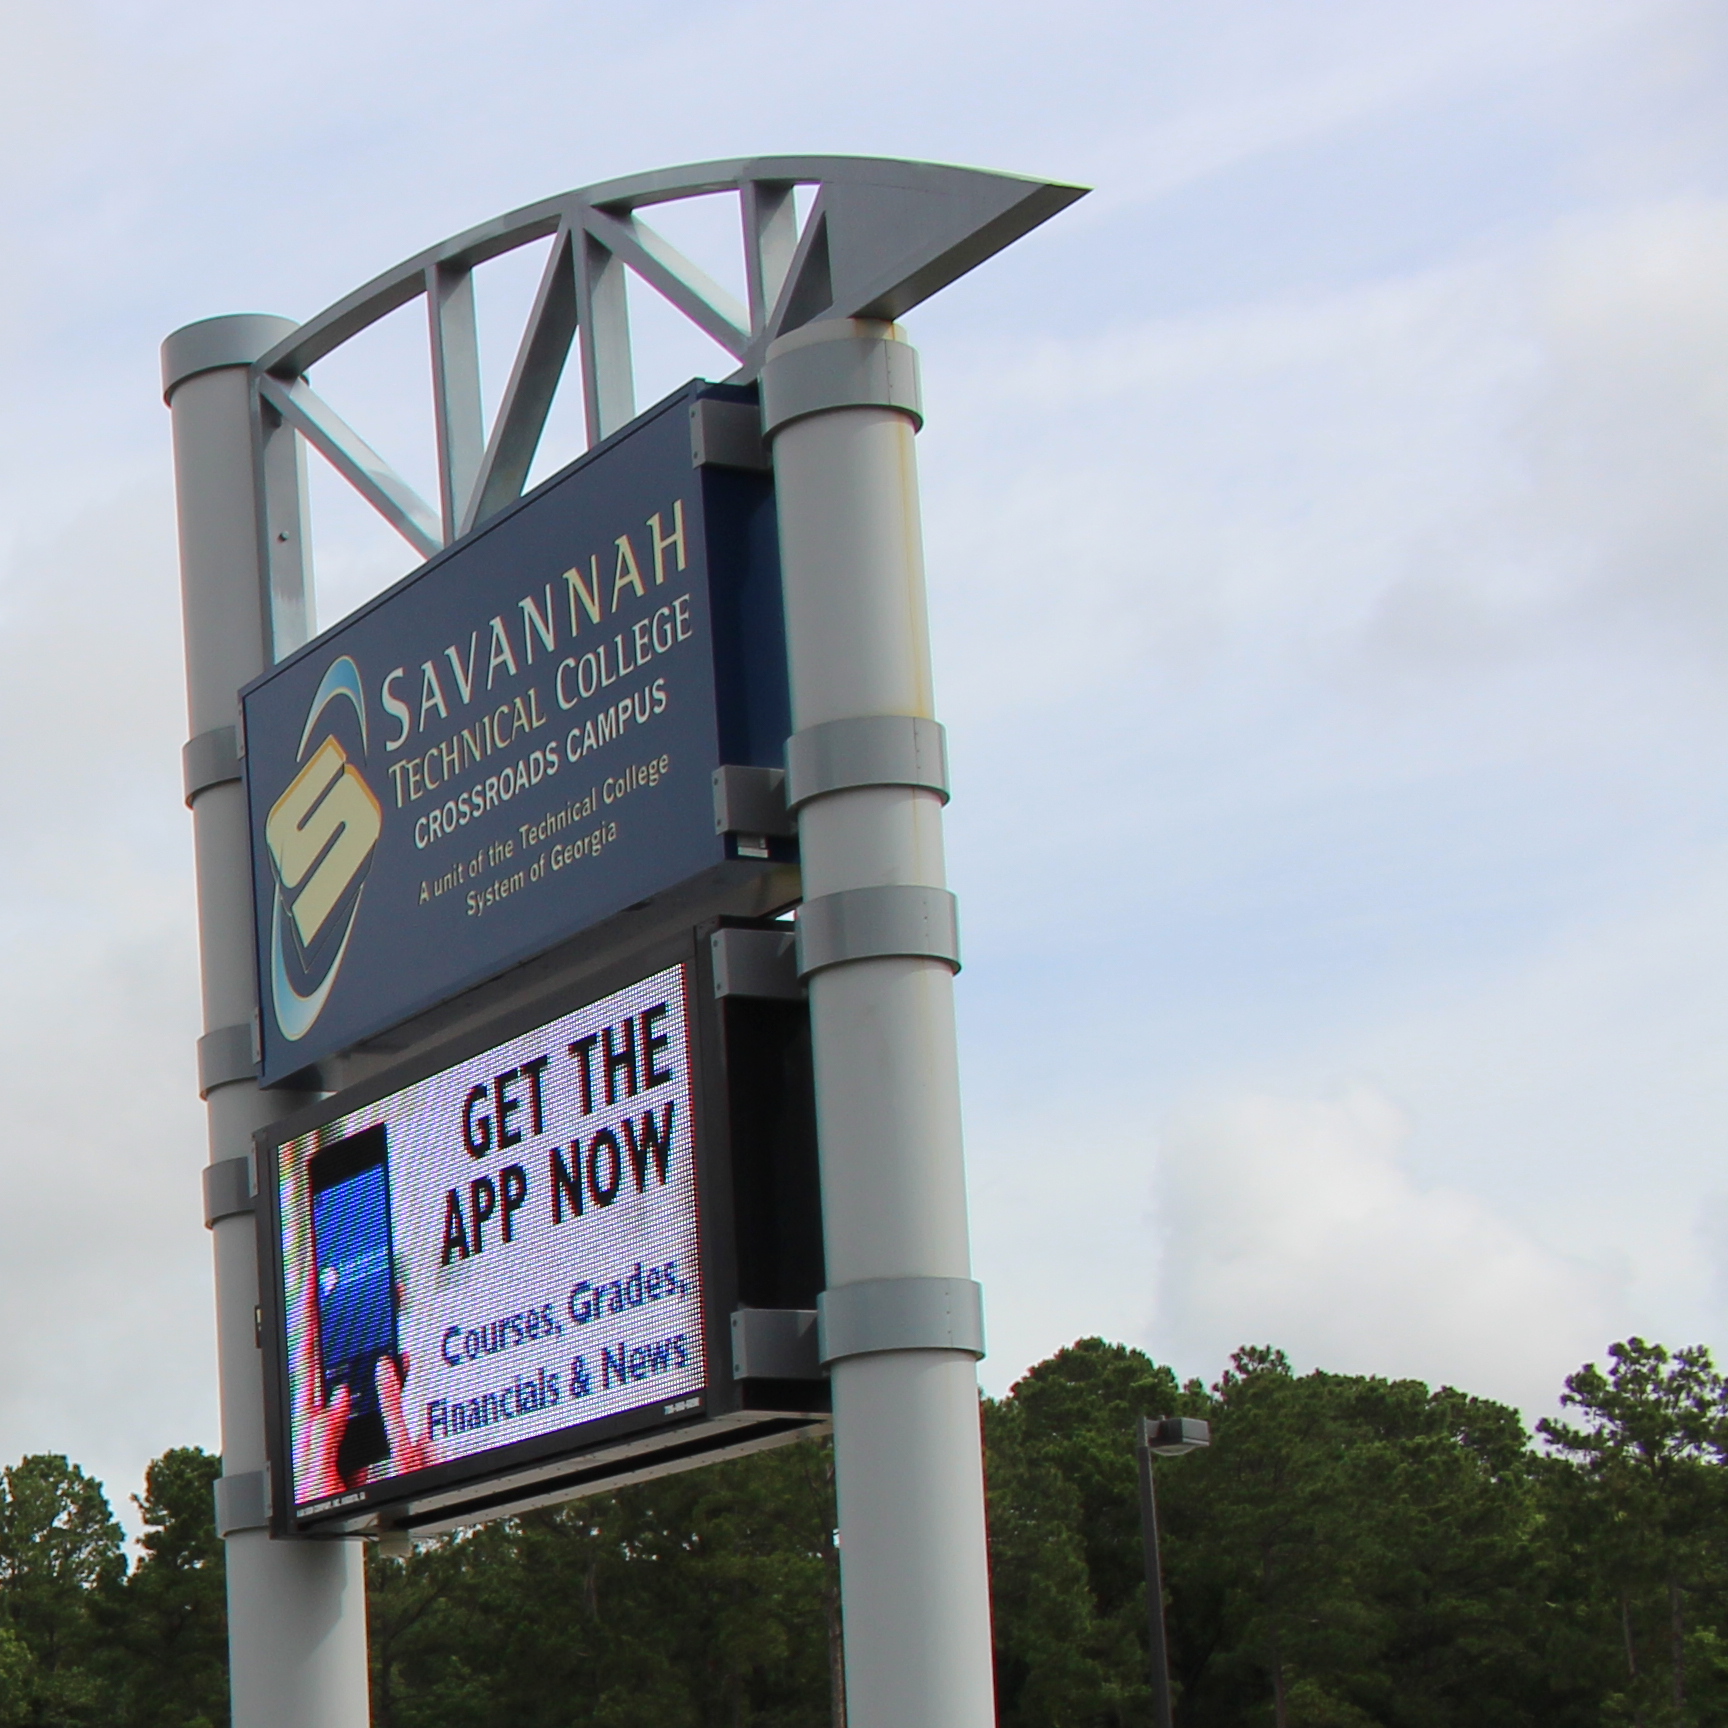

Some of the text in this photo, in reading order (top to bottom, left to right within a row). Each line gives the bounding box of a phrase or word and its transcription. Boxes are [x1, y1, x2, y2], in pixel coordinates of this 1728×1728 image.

[381, 498, 687, 752] SAVANNAH
[388, 592, 693, 808] TECHNICAL COLLEGE
[414, 677, 668, 850] CROSSROADS CAMPUS
[418, 753, 670, 906] A unit of the Technical College
[466, 820, 617, 917] System of Georgia
[461, 1001, 673, 1161] GET THE
[440, 1100, 675, 1267] APP NOW
[425, 1333, 690, 1441] Financials & News
[440, 1261, 690, 1368] Courses, Grades,
